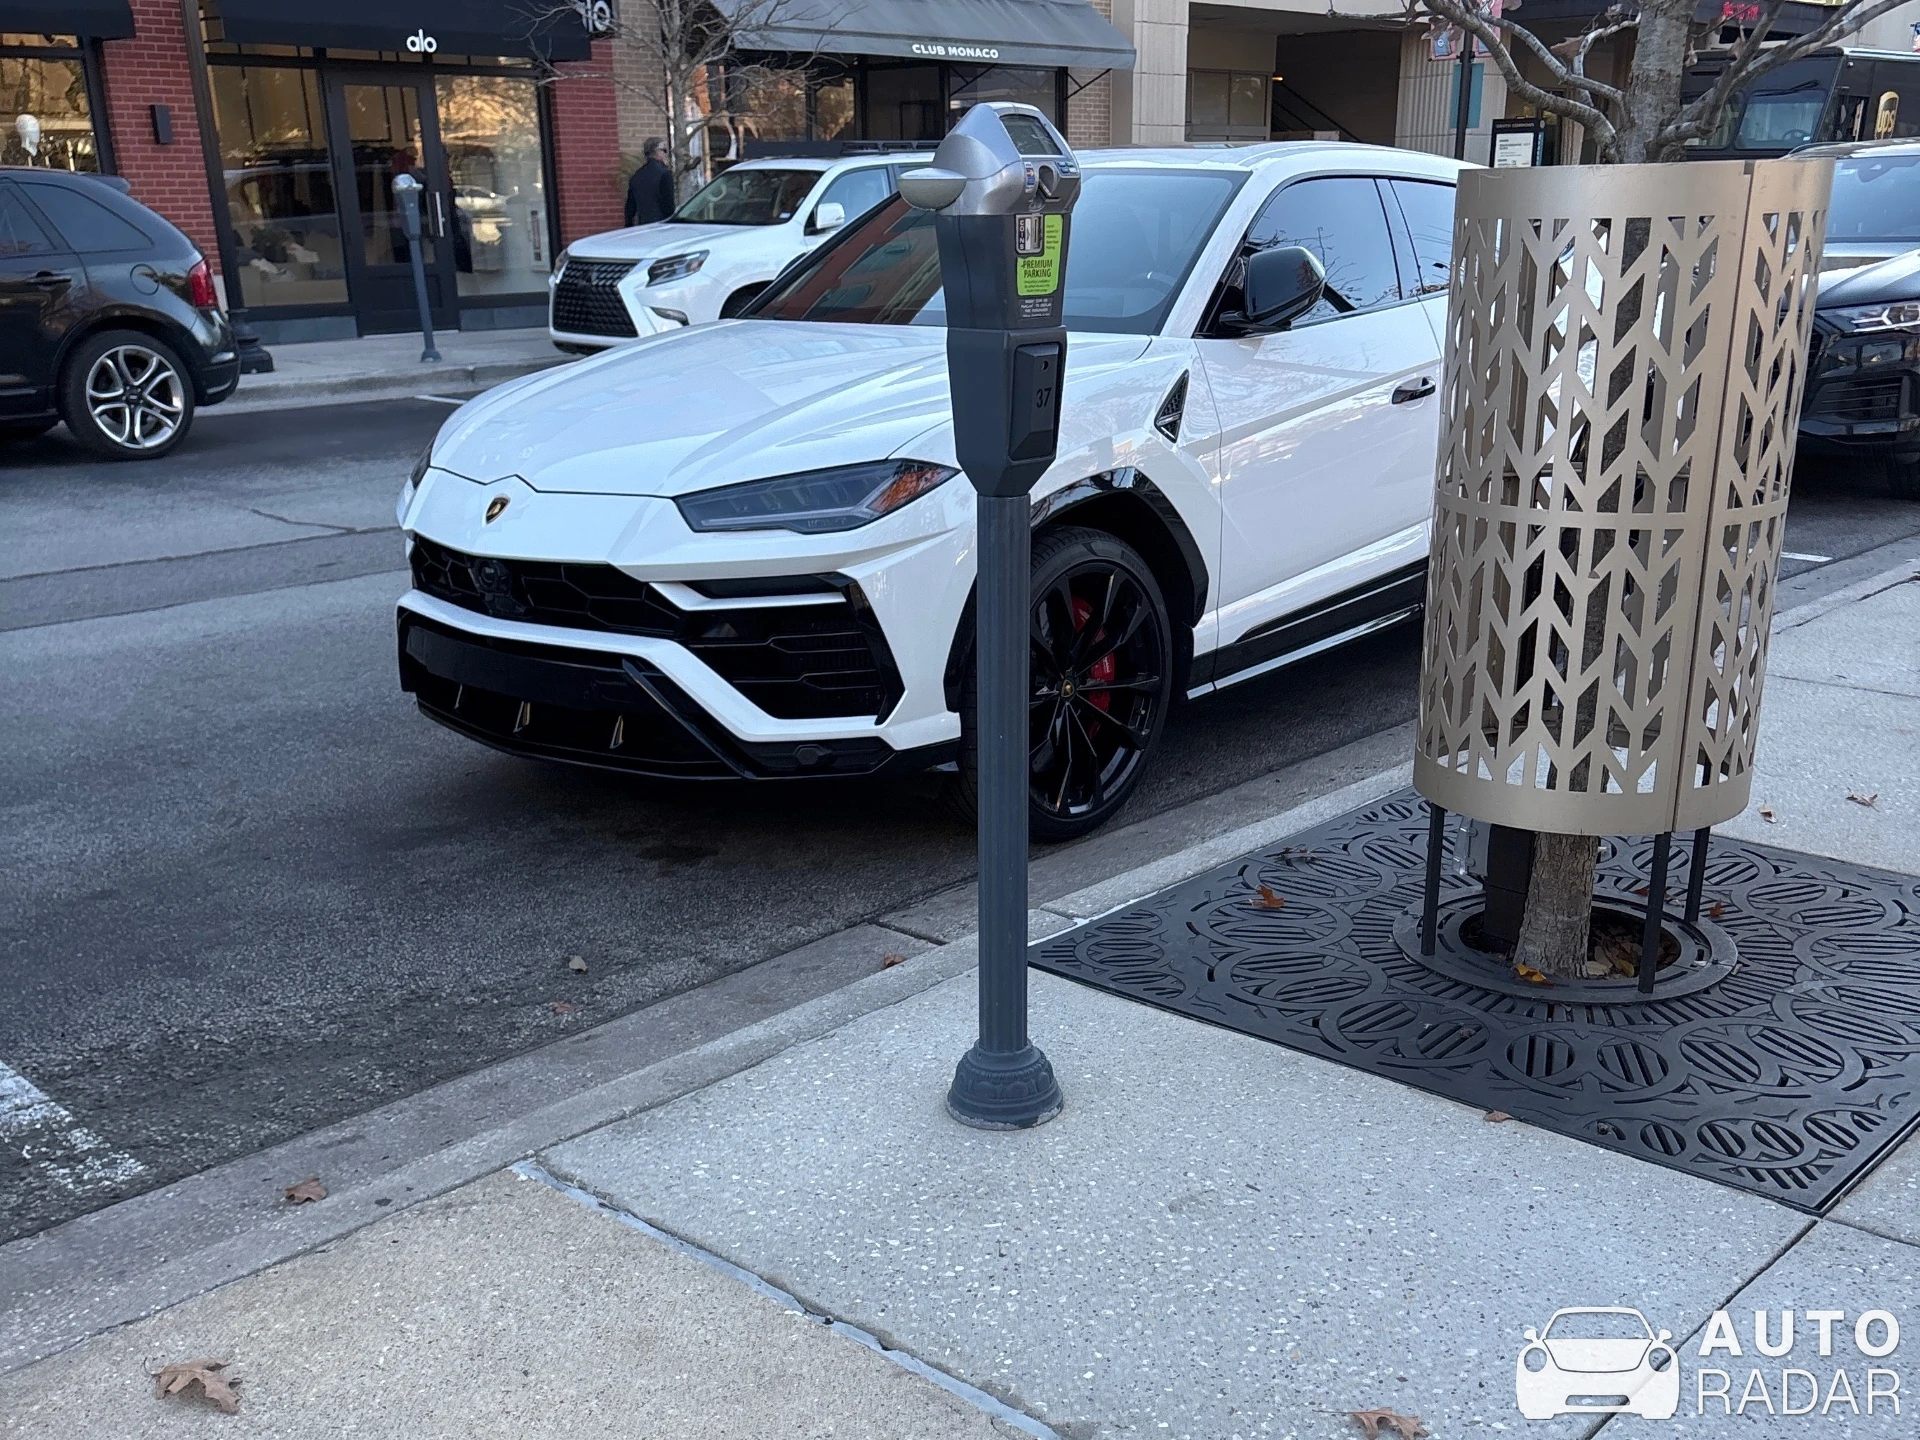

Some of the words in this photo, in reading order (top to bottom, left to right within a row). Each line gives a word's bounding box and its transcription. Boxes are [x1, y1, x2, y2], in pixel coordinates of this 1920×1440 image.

[581, 0, 611, 32] lo
[406, 28, 437, 52] alo
[912, 44, 945, 55] CLUB
[948, 46, 998, 58] MONACO
[1876, 109, 1897, 139] ups
[1023, 259, 1053, 269] PREMIUM
[1023, 269, 1052, 278] PARKING
[1036, 387, 1052, 408] 37
